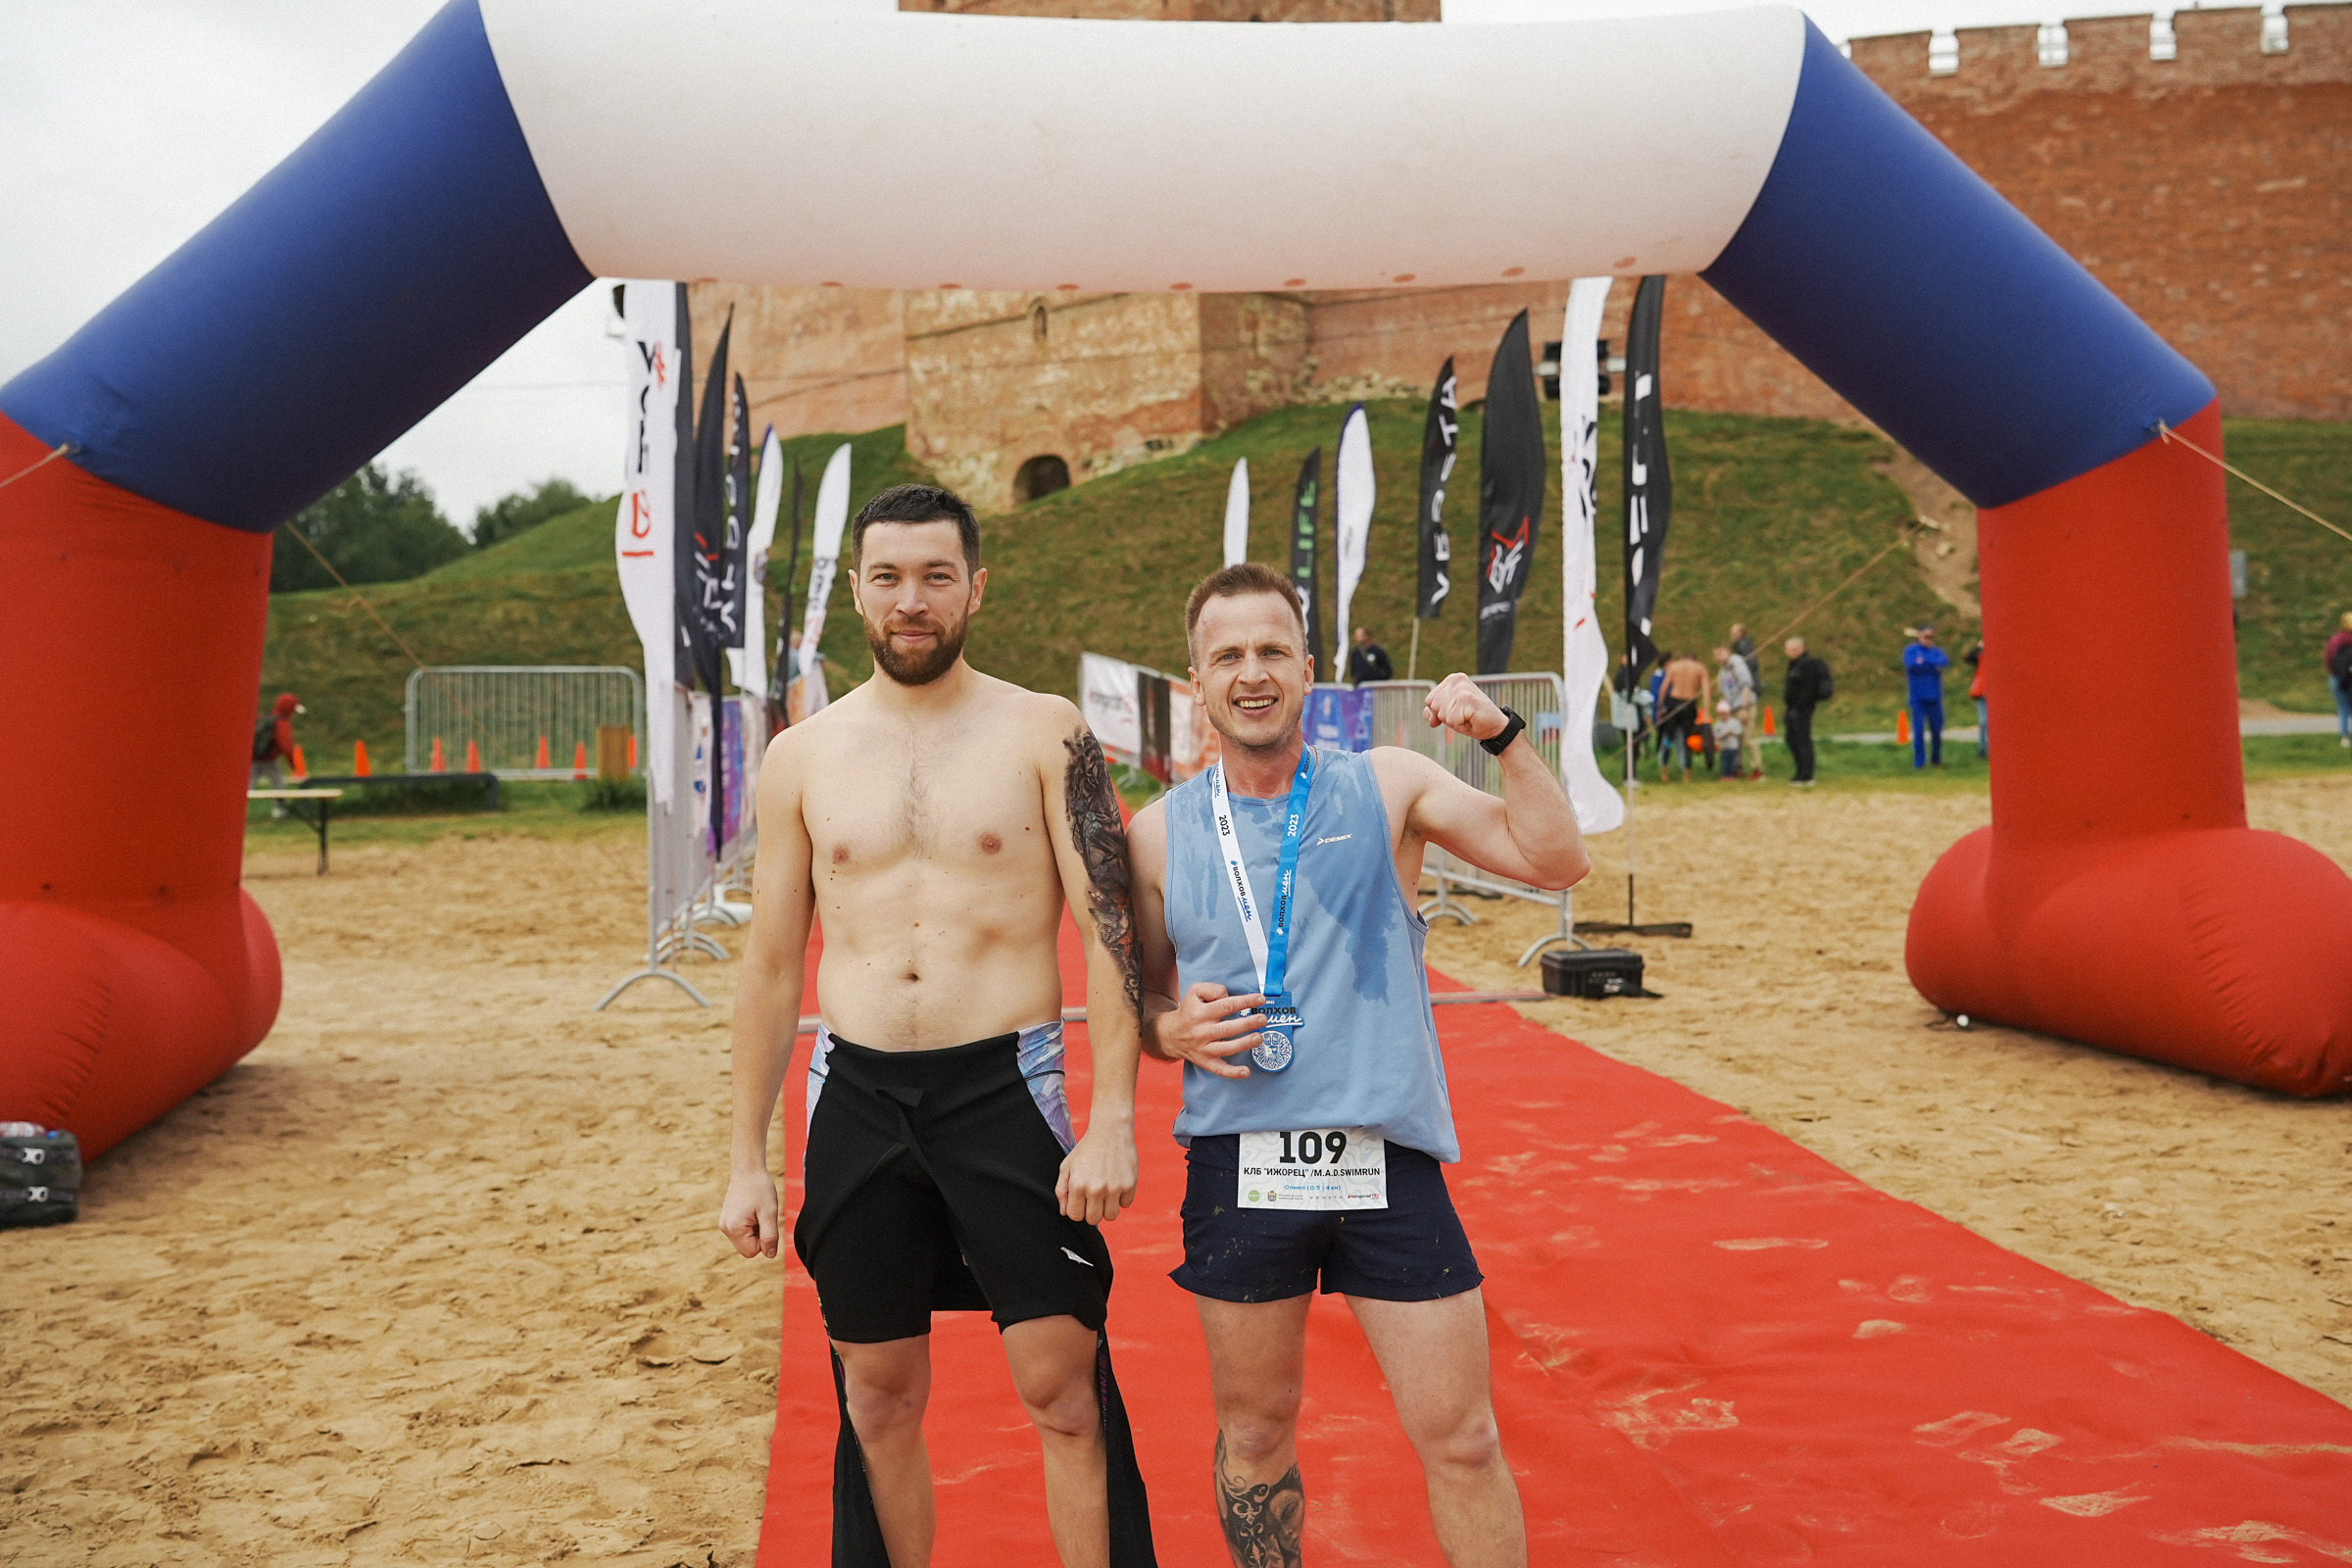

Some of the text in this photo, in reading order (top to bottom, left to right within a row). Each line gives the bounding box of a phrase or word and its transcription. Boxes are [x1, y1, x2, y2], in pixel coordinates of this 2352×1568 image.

[1297, 480, 1316, 578] LIFE
[1218, 814, 1231, 836] 2023
[1287, 813, 1299, 837] 2023
[1324, 833, 1352, 844] DEMIX
[1279, 1131, 1348, 1165] 109
[1244, 1167, 1262, 1176] КЛБ
[1263, 1167, 1309, 1178] "ИЖОРЕЦ"
